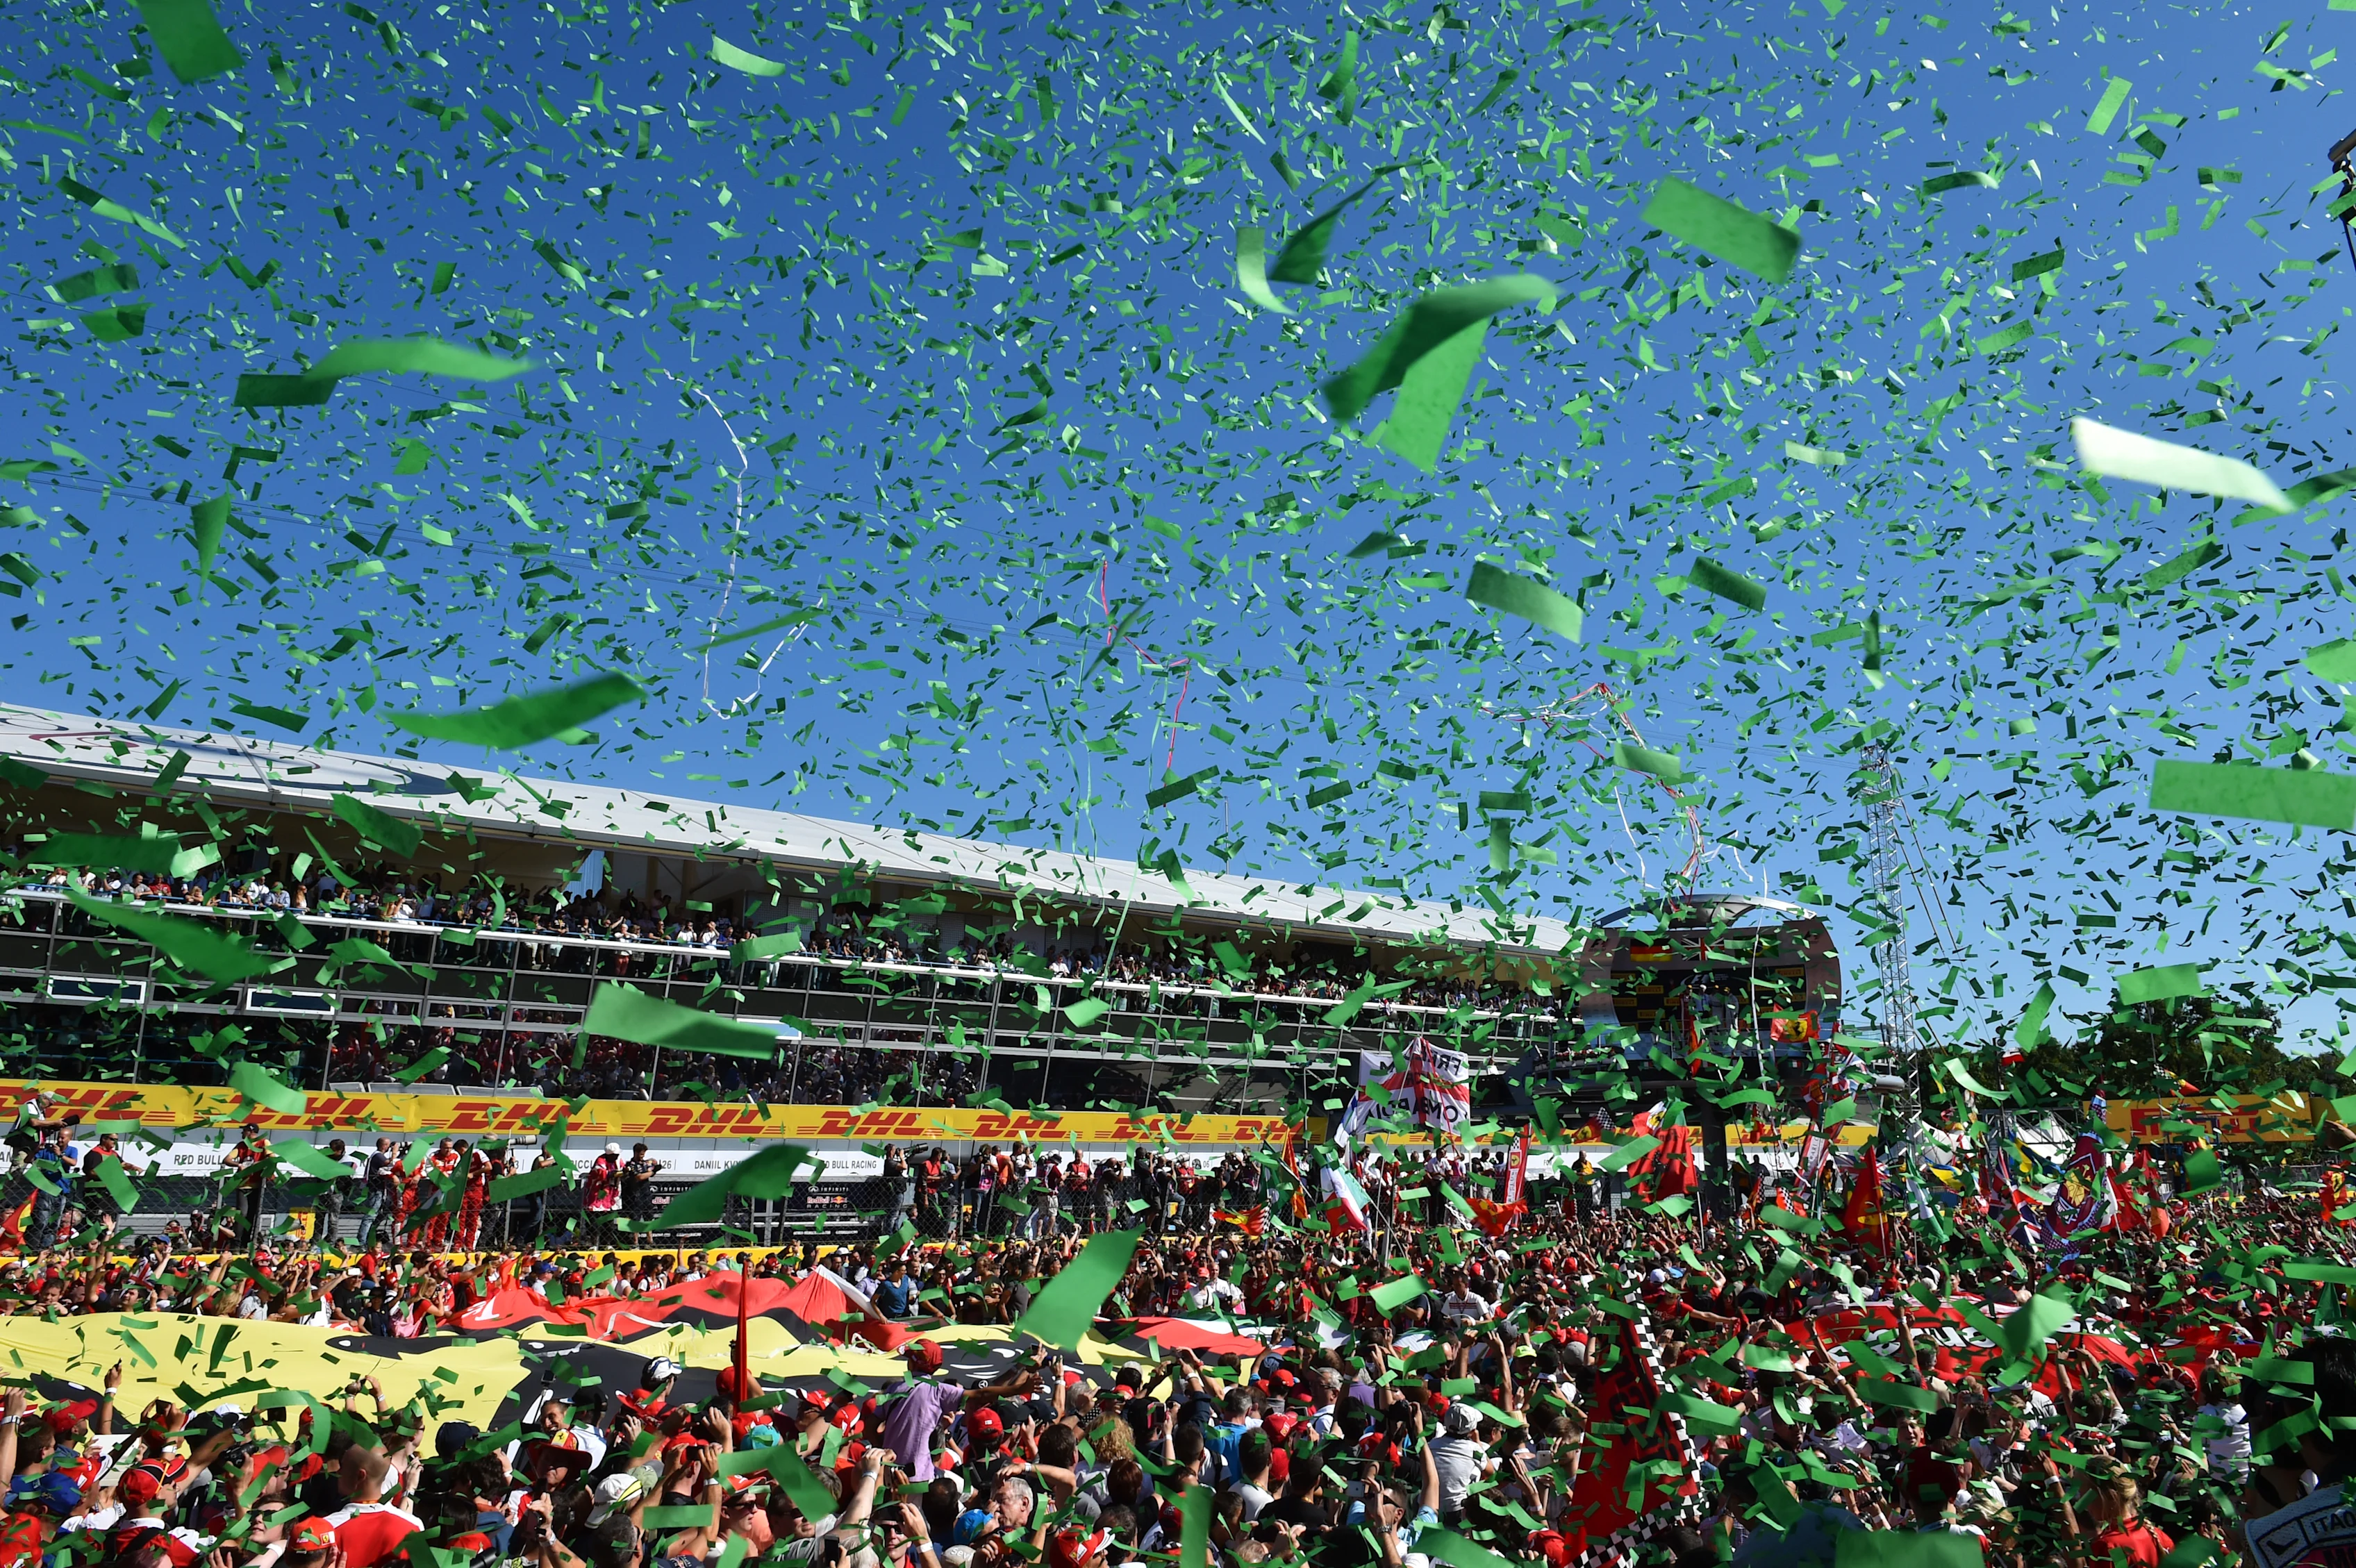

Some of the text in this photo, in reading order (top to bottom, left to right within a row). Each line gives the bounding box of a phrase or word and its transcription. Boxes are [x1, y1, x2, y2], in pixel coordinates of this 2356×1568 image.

[447, 1102, 584, 1131] DHL
[644, 1108, 765, 1134] DHL
[817, 1111, 924, 1135] DHL
[972, 1115, 1067, 1138] DHL
[174, 1154, 223, 1165] RED BULL
[694, 1160, 722, 1169] DANIIL
[832, 1160, 849, 1169] BULL
[851, 1160, 877, 1169] RACING
